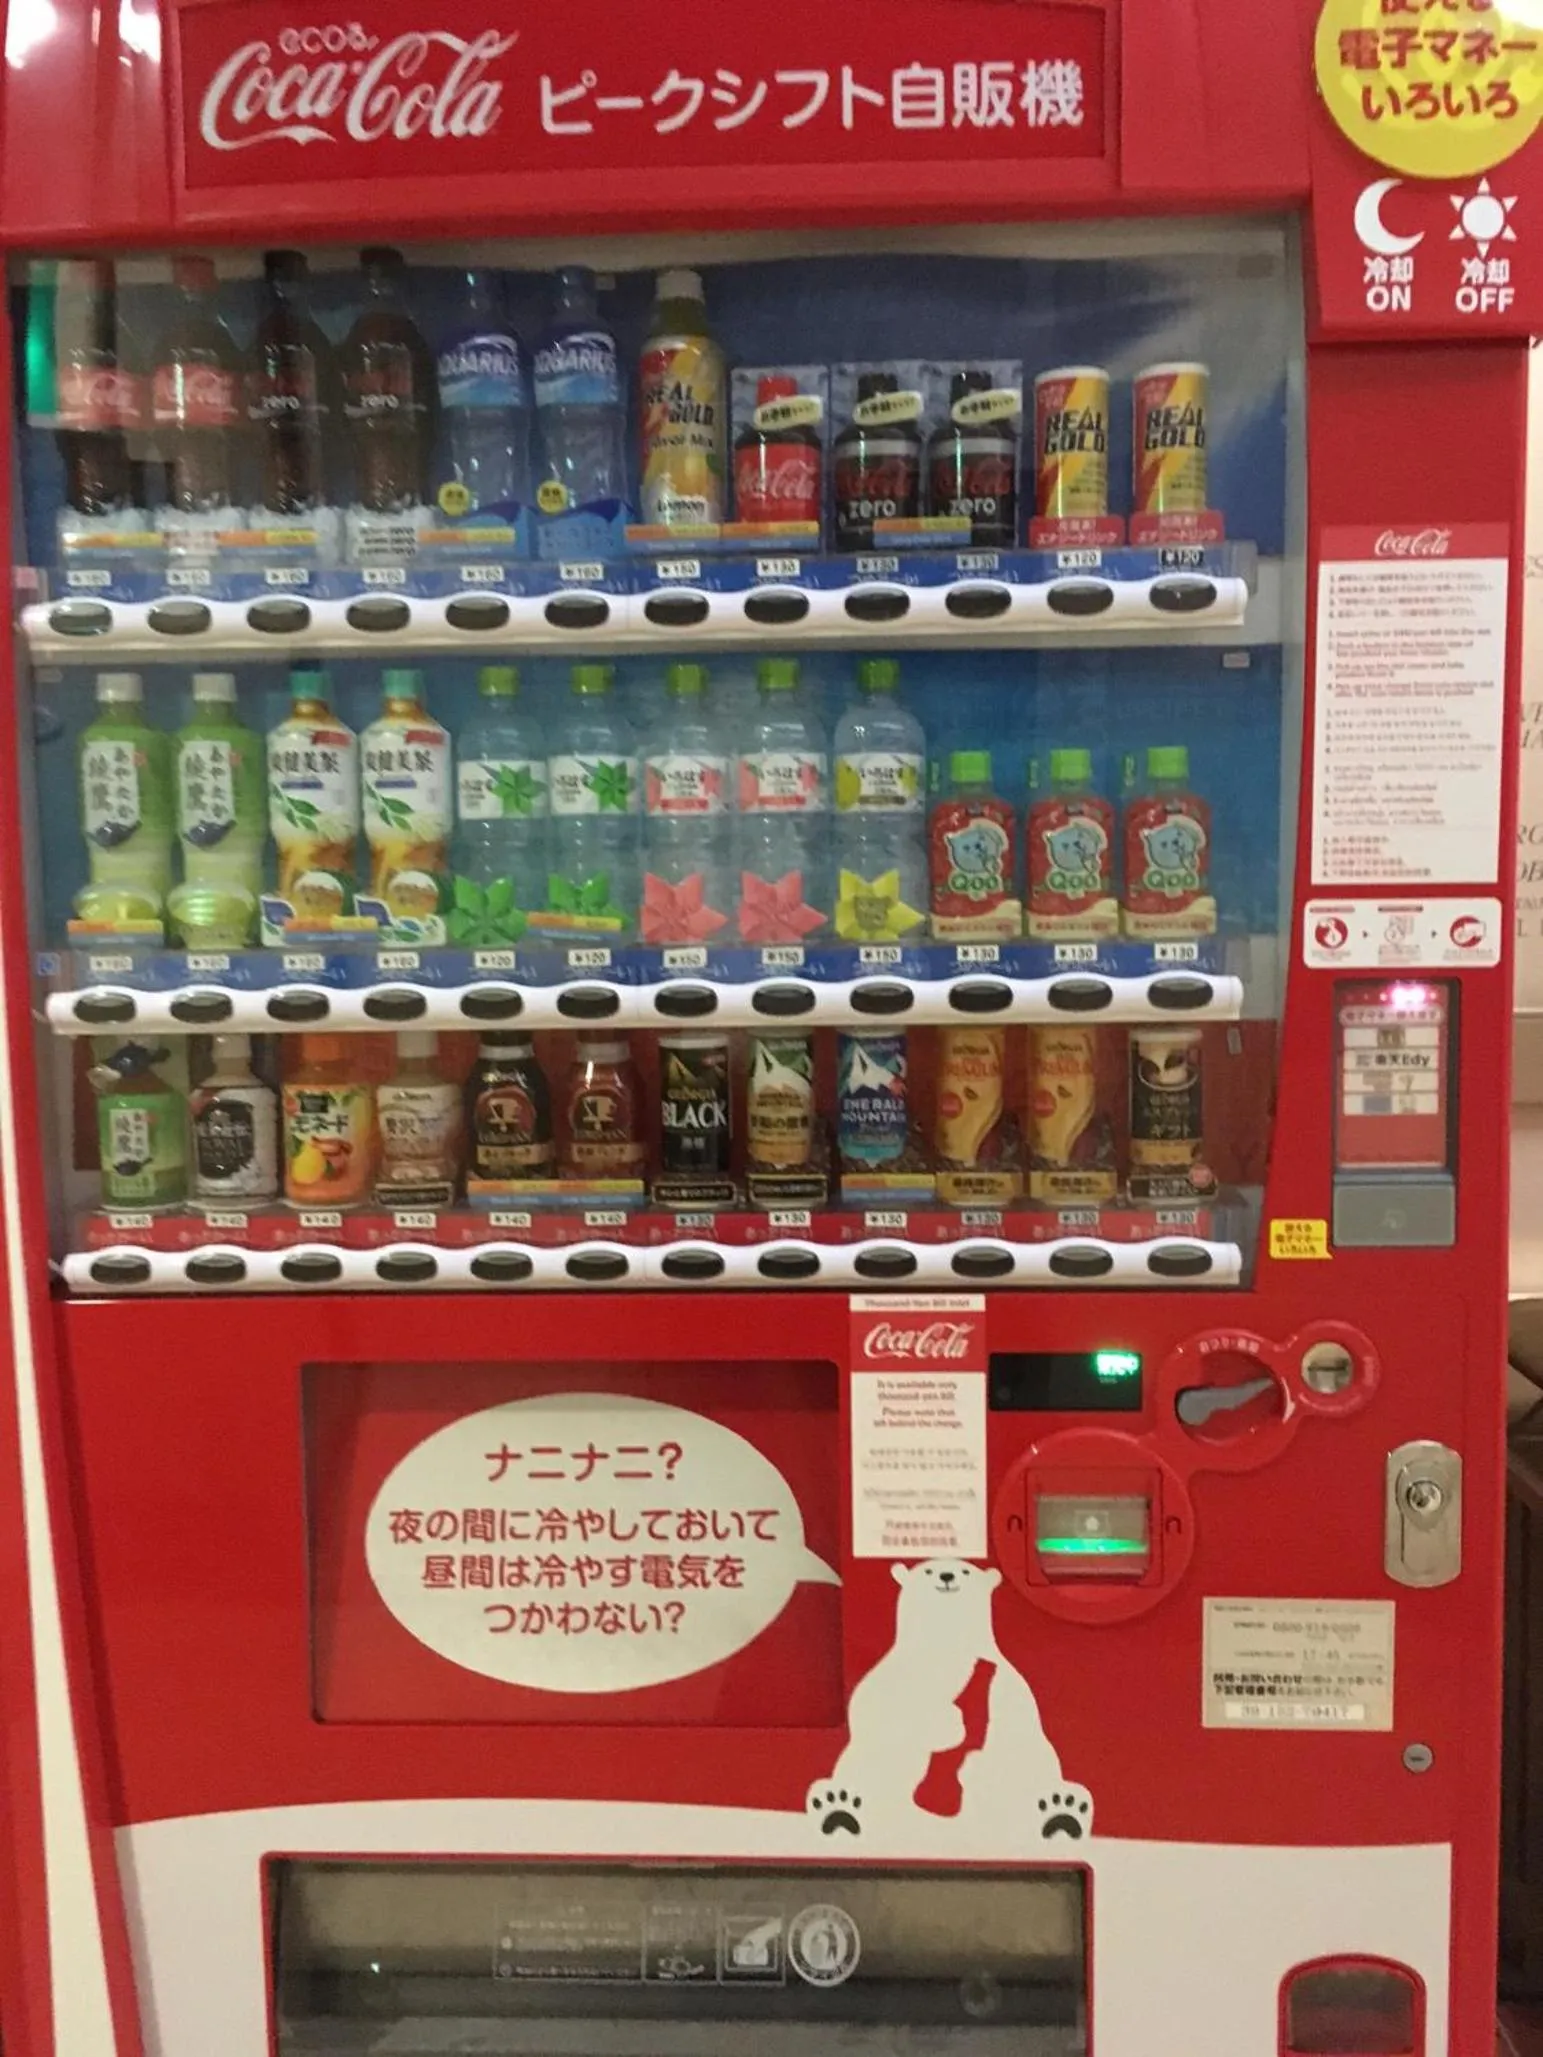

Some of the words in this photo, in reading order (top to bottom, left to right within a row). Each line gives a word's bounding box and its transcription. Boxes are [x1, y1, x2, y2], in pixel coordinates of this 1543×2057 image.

[1338, 27, 1538, 70] 電子マネー
[540, 58, 1085, 135] ピークシフト自販機
[1361, 80, 1519, 121] いろいろ
[1363, 257, 1414, 284] 冷却
[1460, 257, 1511, 285] 冷却
[1365, 285, 1412, 312] ON
[1454, 286, 1515, 313] OFF
[1046, 405, 1102, 432] REAL
[1147, 401, 1203, 428] REAL
[1043, 427, 1105, 455] GOLD
[1144, 424, 1206, 451] GOLD
[850, 499, 897, 518] zero
[950, 496, 996, 515] zero
[951, 873, 998, 891] Qoo
[1049, 871, 1099, 889] Qoo
[1148, 869, 1198, 888] Qoo
[661, 1101, 727, 1128] BLACK
[484, 1442, 684, 1482] ナニナニ?
[389, 1507, 780, 1544] 夜の間に冷やしておいて
[421, 1554, 746, 1590] 昼間は冷やす電気を
[483, 1601, 687, 1636] つかわない?
